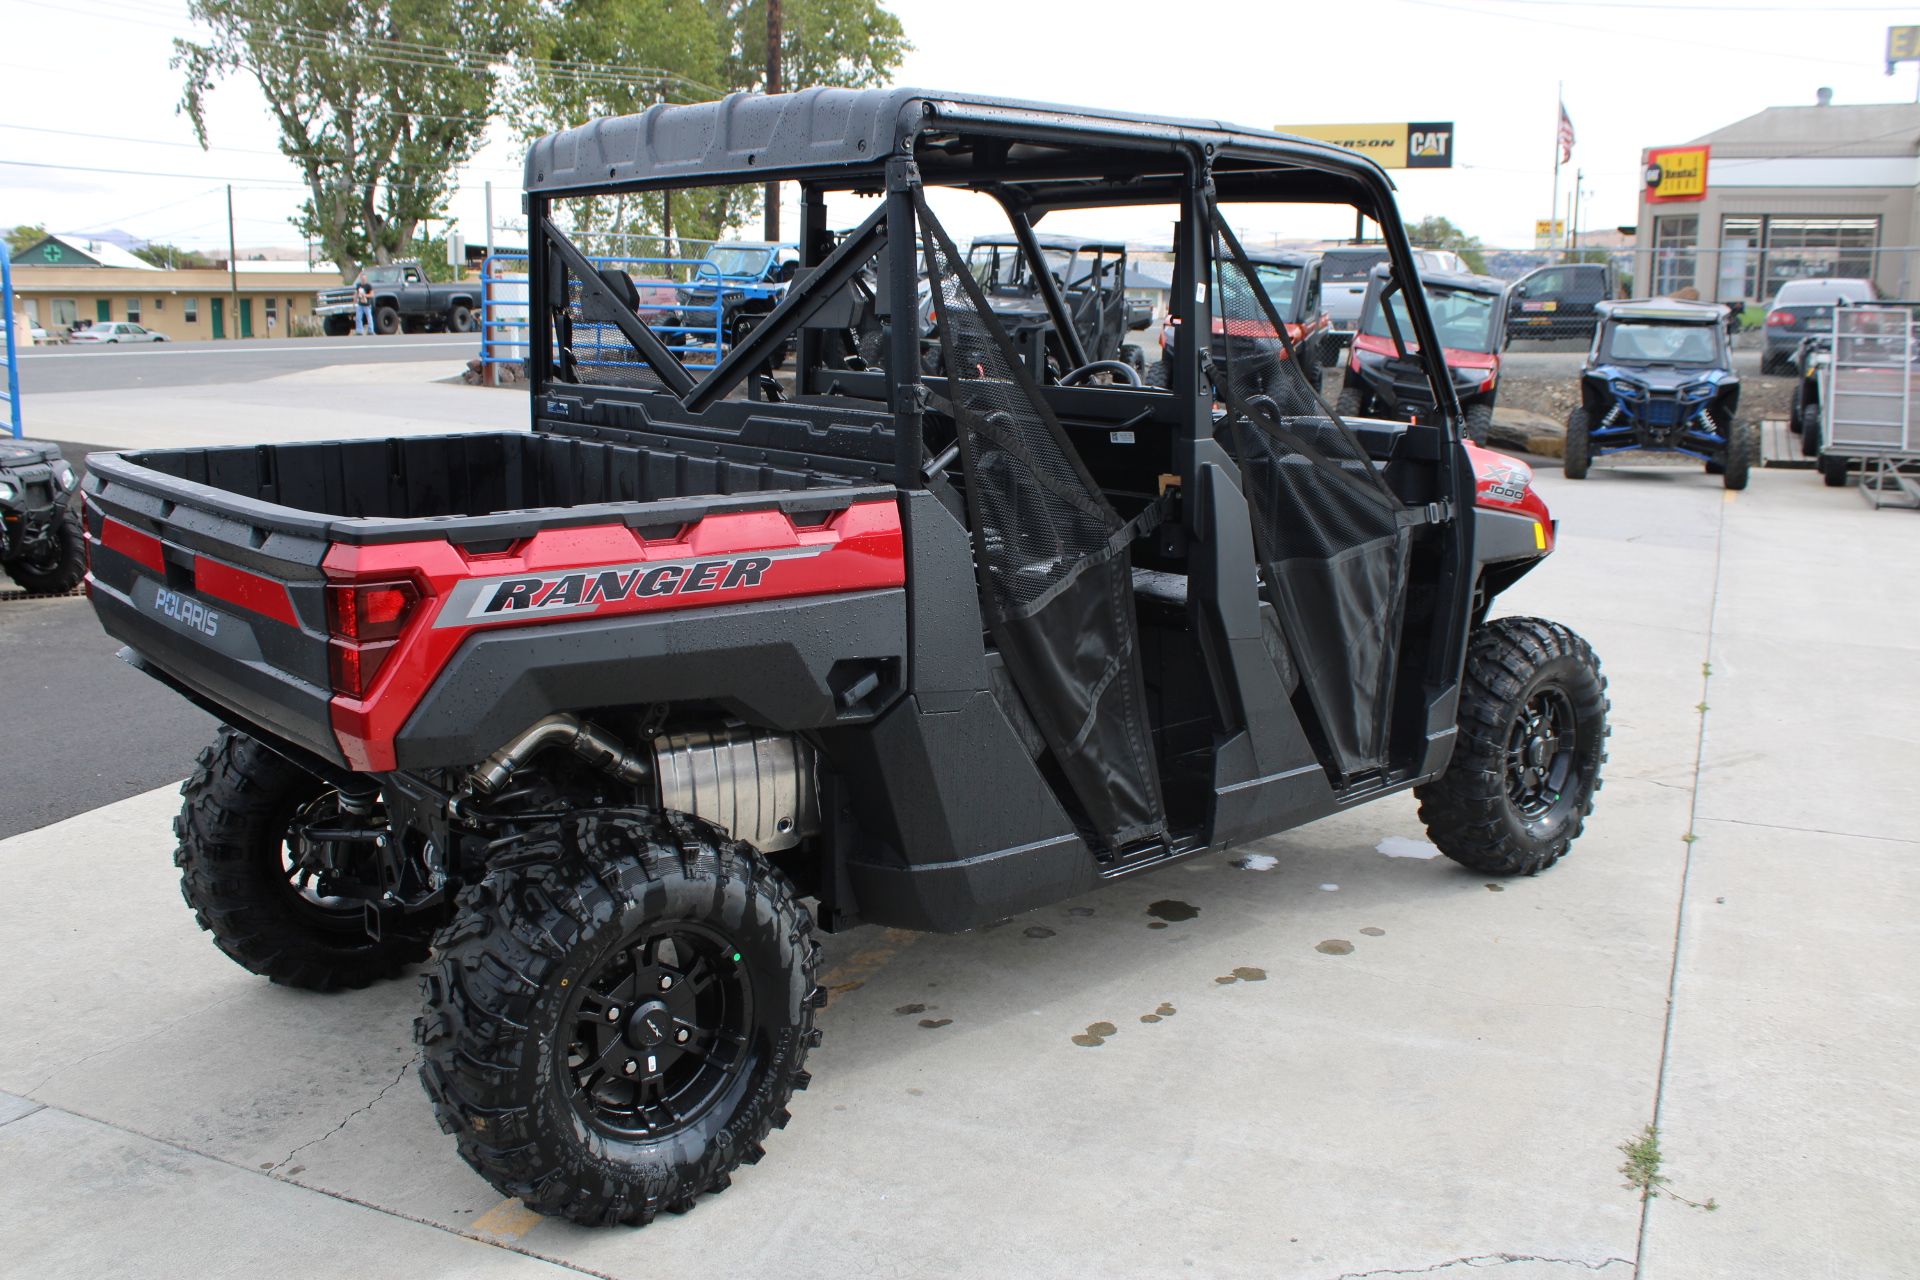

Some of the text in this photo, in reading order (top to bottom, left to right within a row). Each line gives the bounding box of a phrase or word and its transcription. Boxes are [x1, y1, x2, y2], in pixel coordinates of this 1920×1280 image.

[1327, 132, 1449, 156] ERSON CAT
[1480, 463, 1528, 484] XP
[1490, 485, 1524, 499] 1000
[483, 556, 772, 613] RANGER
[155, 588, 218, 636] POLARIS
